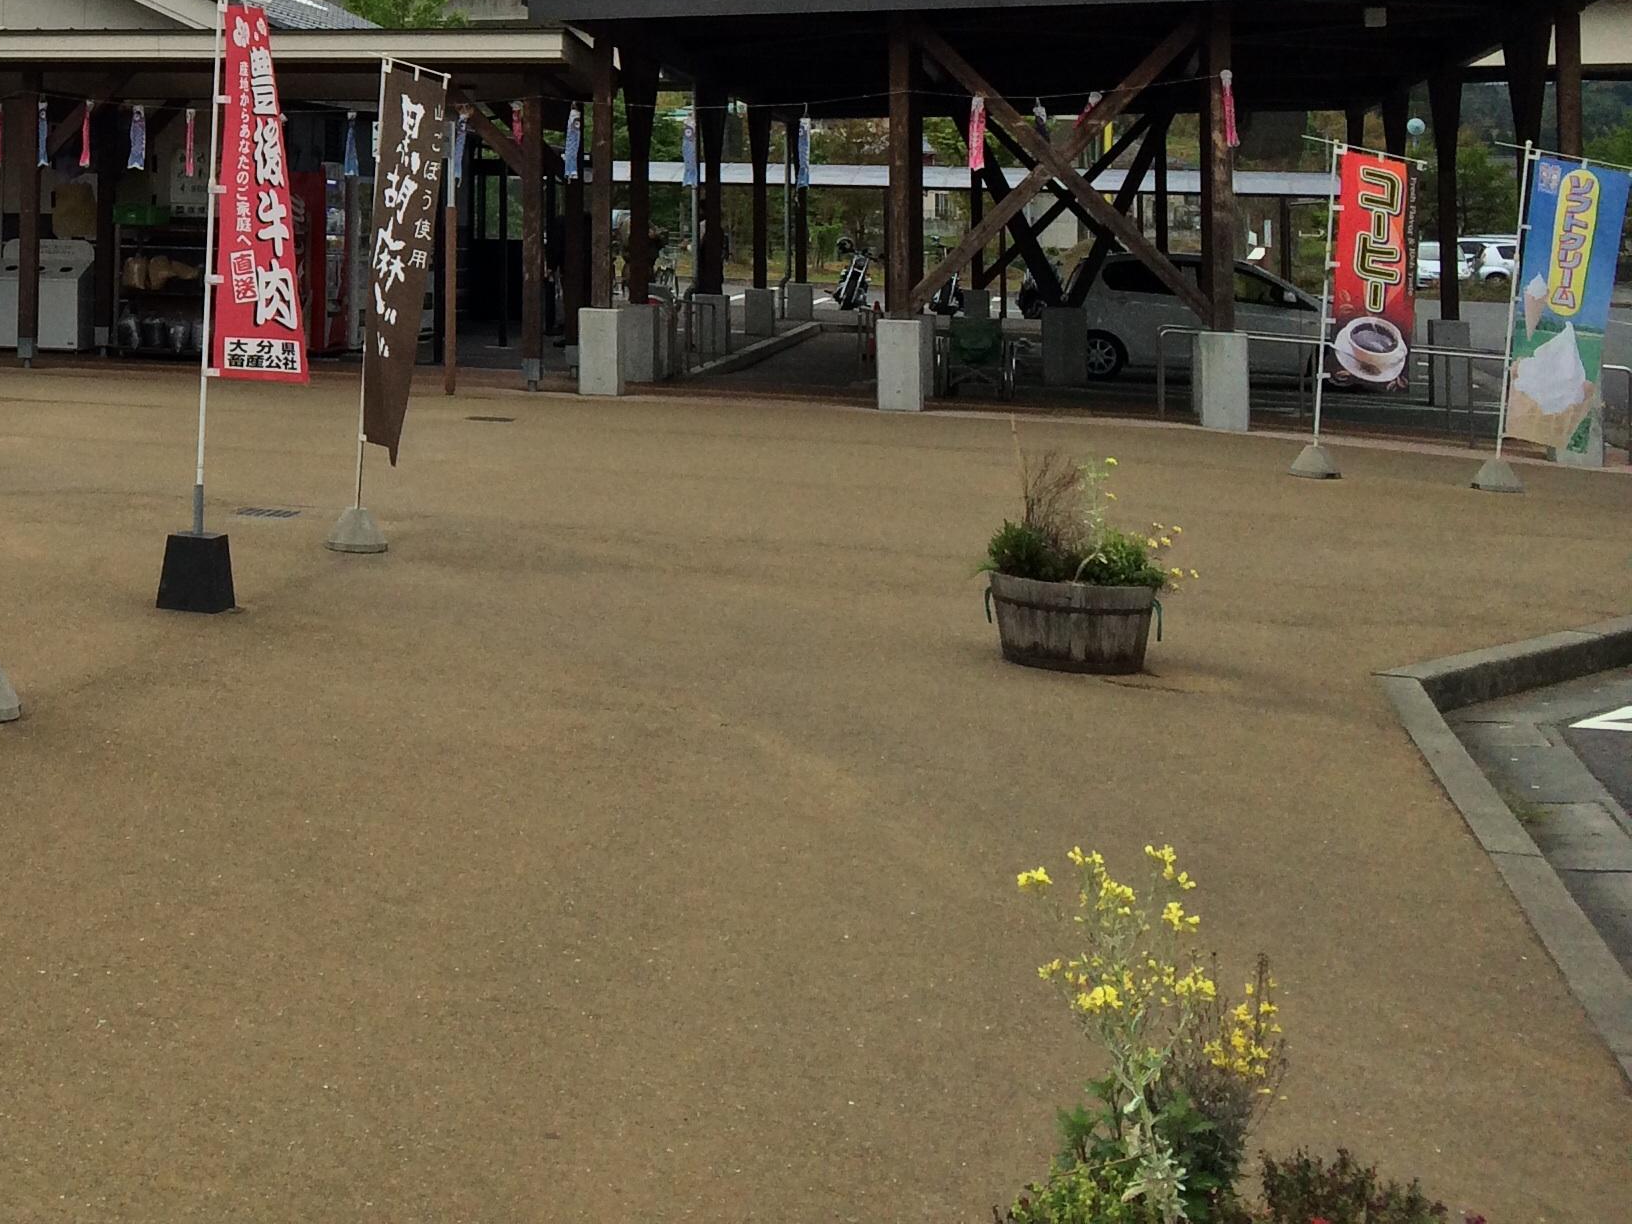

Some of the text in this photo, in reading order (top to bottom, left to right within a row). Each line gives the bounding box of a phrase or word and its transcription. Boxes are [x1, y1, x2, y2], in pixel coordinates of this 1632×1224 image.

[235, 61, 252, 247] 産地からあなたのご家庭へ
[249, 46, 298, 330] 豊後牛肉
[408, 104, 443, 269] 山ごぼう使用
[232, 252, 258, 301] 直送
[1354, 165, 1404, 313] コーヒー
[1551, 175, 1595, 310] ソフトクリーム
[227, 353, 298, 371] 畜産公社
[229, 339, 296, 356] 大分県
